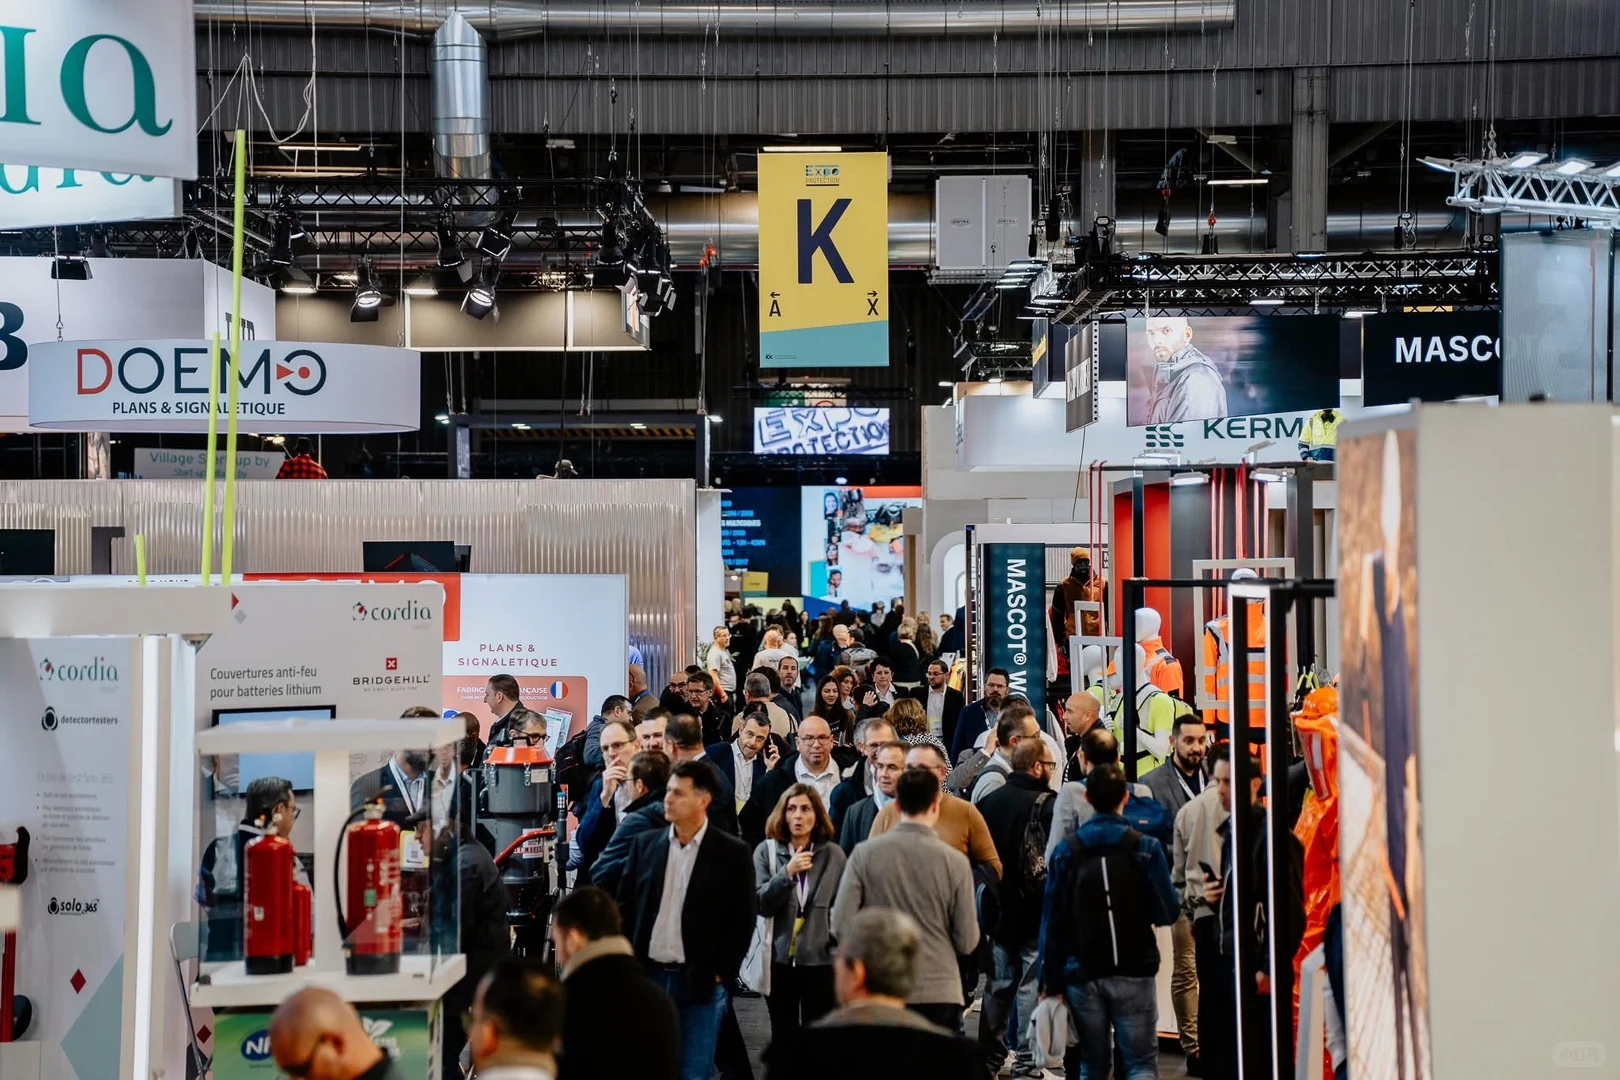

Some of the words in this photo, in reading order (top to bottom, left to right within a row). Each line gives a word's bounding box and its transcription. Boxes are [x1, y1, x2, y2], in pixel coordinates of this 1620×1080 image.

[797, 198, 855, 285] K
[769, 300, 782, 317] A
[867, 298, 879, 316] X
[112, 402, 157, 414] PLANS
[161, 402, 172, 414] &
[175, 402, 286, 416] SIGNLTIQUE
[1203, 417, 1304, 439] KERM
[760, 420, 889, 454] OTECTIO
[150, 452, 194, 466] Village
[255, 455, 270, 468] by
[371, 600, 432, 621] cordia
[479, 644, 523, 652] PLANS
[528, 644, 535, 652] &
[58, 656, 119, 681] cordia
[458, 658, 558, 668] SIGNALETIQUE
[210, 667, 274, 680] Couvertures
[276, 665, 317, 678] anti-feu
[210, 688, 234, 701] pour
[237, 685, 284, 697] batteries
[286, 683, 322, 695] lithium
[60, 714, 119, 725] detectortesters
[60, 898, 82, 912] solo
